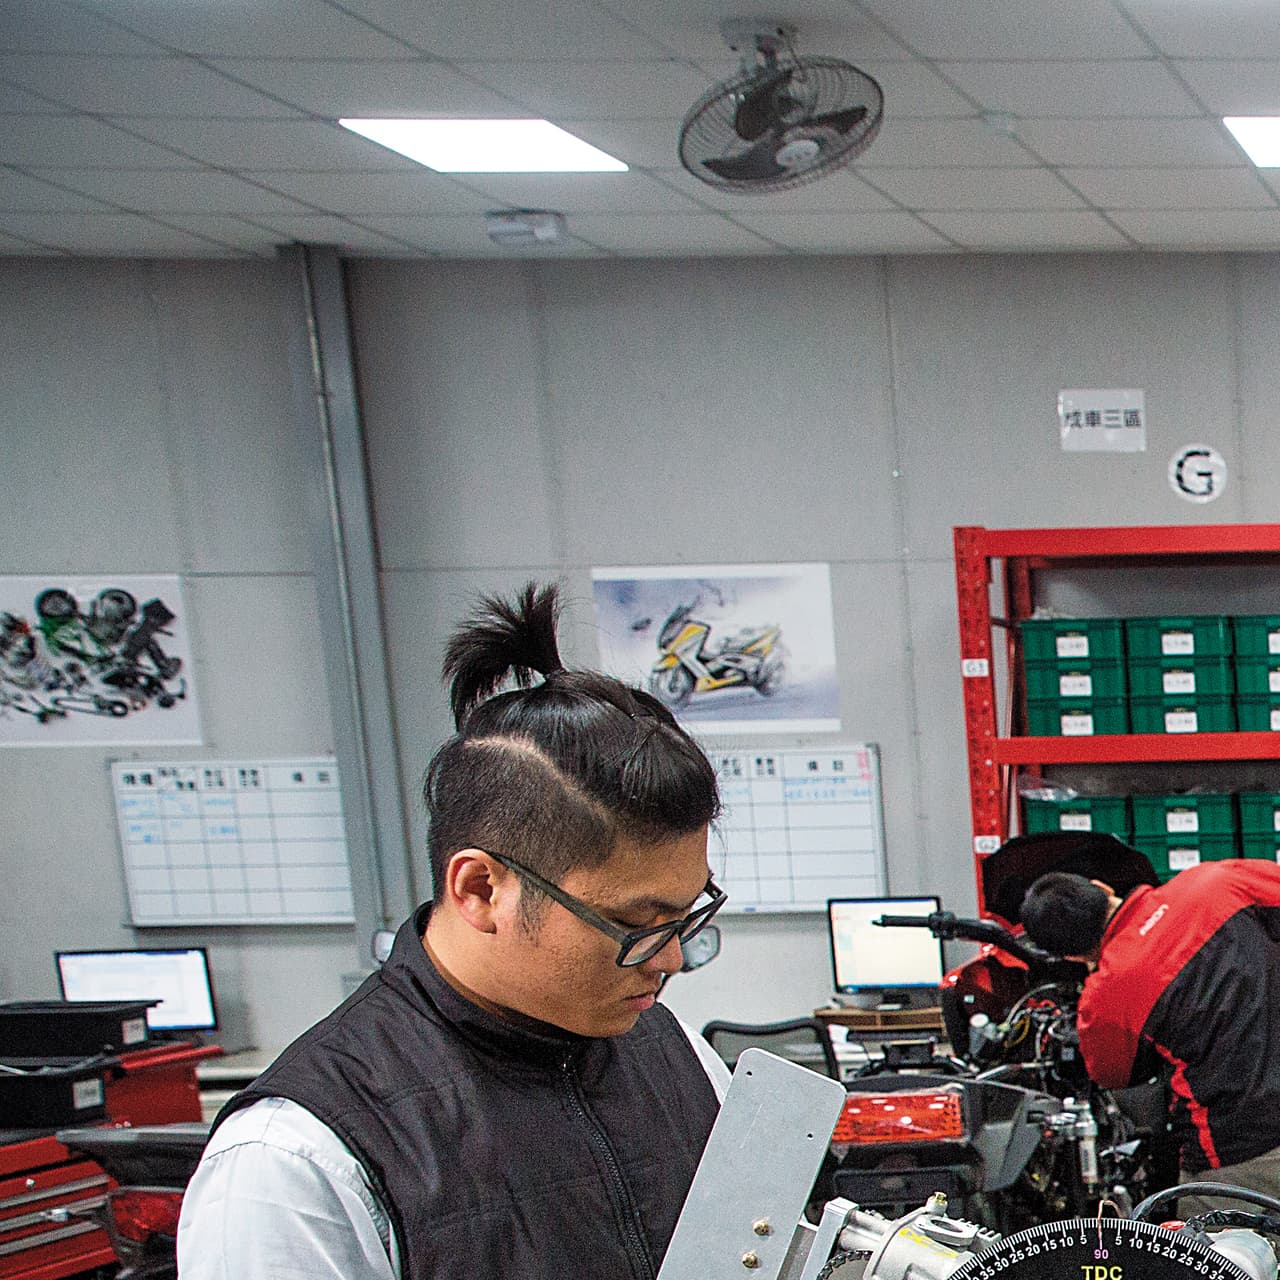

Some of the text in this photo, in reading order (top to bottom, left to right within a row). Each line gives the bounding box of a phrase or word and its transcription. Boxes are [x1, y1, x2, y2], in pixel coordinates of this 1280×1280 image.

[1175, 449, 1214, 496] G
[980, 1268, 996, 1280] 35
[994, 1258, 1010, 1272] 30
[1009, 1252, 1025, 1264] 25
[1025, 1245, 1041, 1257] 20
[1042, 1240, 1058, 1251] 15
[1059, 1237, 1074, 1247] 10
[1080, 1236, 1088, 1245] 5
[1081, 1265, 1123, 1280] TDC
[1093, 1249, 1109, 1260] 90
[1115, 1237, 1122, 1245] 5
[1129, 1239, 1144, 1249] 10
[1146, 1242, 1160, 1253] 15
[1161, 1247, 1177, 1259] 20
[1177, 1253, 1194, 1266] 25
[1194, 1261, 1209, 1274] 30
